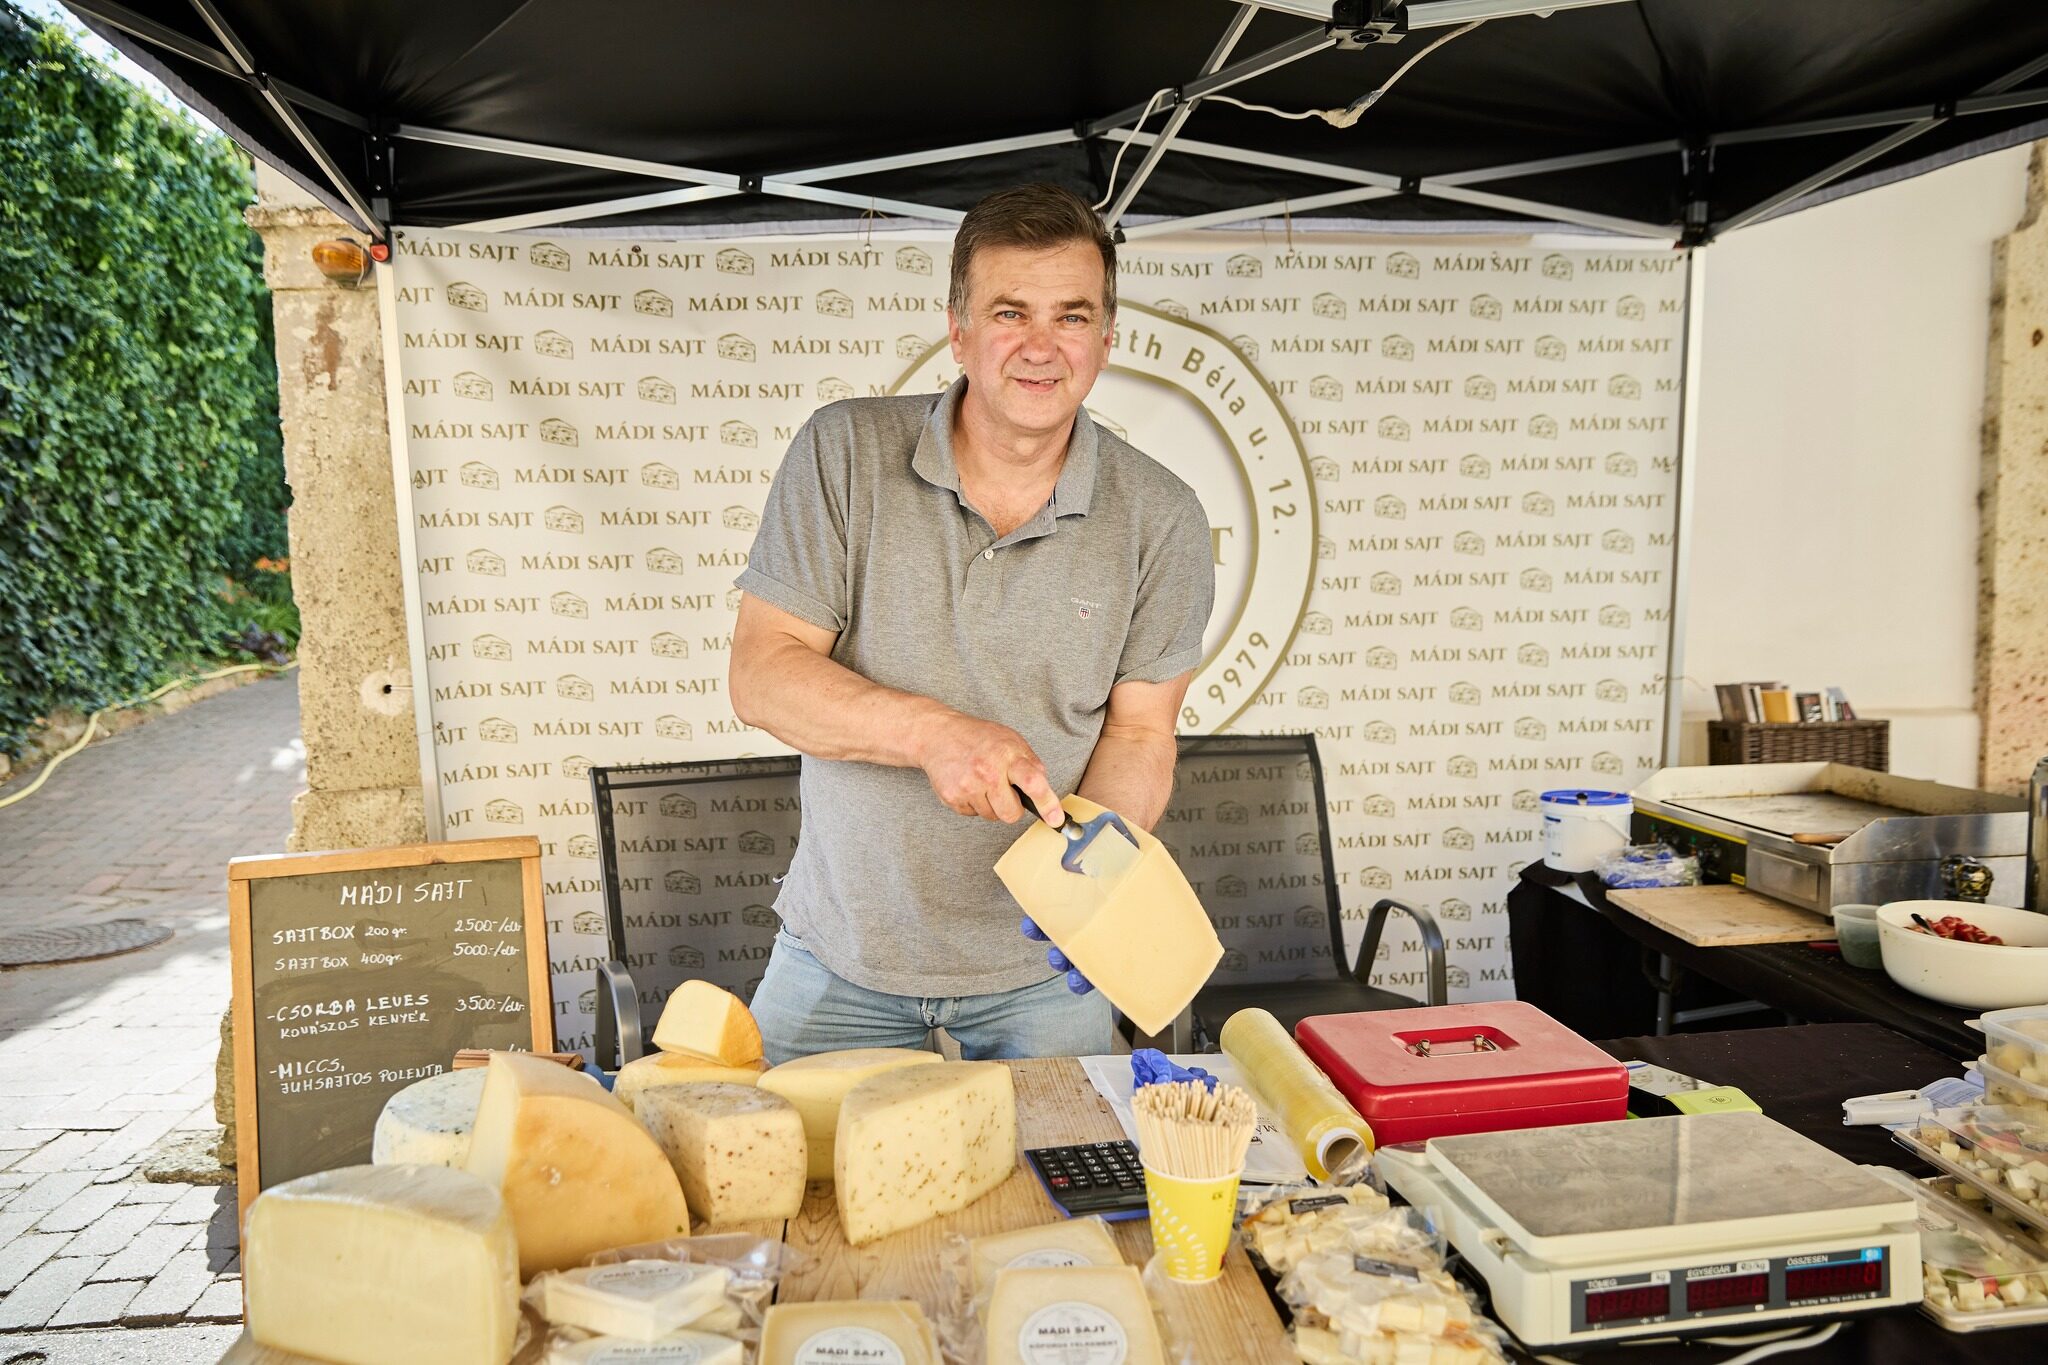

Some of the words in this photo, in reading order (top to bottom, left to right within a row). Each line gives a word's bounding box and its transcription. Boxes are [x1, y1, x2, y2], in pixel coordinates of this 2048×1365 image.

[588, 250, 649, 267] MÁDI
[657, 254, 705, 271] SAJT
[770, 248, 830, 267] MÁDI
[836, 250, 884, 269] SAJT
[1117, 256, 1164, 276] MÁDI
[1170, 263, 1211, 279] SAJT
[1433, 253, 1486, 271] MÁDI
[1490, 256, 1532, 273] SAJT
[1584, 254, 1634, 272] MÁDI
[1639, 254, 1677, 274] SAJT
[503, 288, 564, 307] MÁDI
[572, 294, 622, 311] SAJT
[1200, 295, 1255, 315] MÁDI
[1261, 298, 1302, 314] SAJT
[1358, 294, 1411, 312] MÁDI
[1417, 299, 1459, 315] SAJT
[404, 328, 468, 348] MÁDI
[475, 334, 521, 353] SAJT
[590, 333, 651, 353] MÁDI
[658, 340, 707, 357] SAJT
[772, 335, 831, 353] MÁDI
[838, 340, 885, 357] SAJT
[1271, 335, 1325, 352] MÁDI
[1331, 339, 1372, 355] SAJT
[1427, 335, 1479, 352] MÁDI
[1484, 339, 1524, 355] SAJT
[1577, 335, 1629, 352] MÁDI
[1630, 339, 1673, 354] SAJT
[509, 376, 570, 395] MÁDI
[578, 382, 625, 399] SAJT
[1355, 375, 1407, 393] MÁDI
[1412, 380, 1453, 395] SAJT
[411, 419, 473, 439] MÁDI
[480, 424, 530, 440] SAJT
[595, 420, 655, 439] MÁDI
[662, 426, 709, 442] SAJT
[1423, 415, 1474, 432] MÁDI
[1479, 419, 1519, 434] SAJT
[1569, 414, 1621, 430] MÁDI
[1627, 417, 1669, 432] SAJT
[1181, 346, 1247, 417] Béla
[1248, 426, 1269, 462] u.
[1268, 478, 1298, 535] 12.
[1351, 456, 1403, 473] MÁDI
[1408, 459, 1448, 474] SAJT
[1500, 454, 1549, 470] MÁDI
[1554, 457, 1595, 472] SAJT
[515, 463, 576, 482] MÁDI
[582, 469, 629, 485] SAJT
[1418, 494, 1469, 510] MÁDI
[1473, 496, 1510, 511] SAJT
[419, 507, 480, 528] MÁDI
[487, 512, 534, 529] SAJT
[600, 507, 659, 525] MÁDI
[665, 511, 709, 527] SAJT
[1348, 534, 1399, 551] MÁDI
[1404, 536, 1443, 551] SAJT
[1495, 530, 1547, 547] MÁDI
[1552, 534, 1591, 548] SAJT
[1413, 572, 1463, 586] MÁDI
[1469, 572, 1508, 587] SAJT
[1563, 568, 1615, 584] MÁDI
[1620, 570, 1662, 585] SAJT
[426, 594, 486, 616] MÁDI
[493, 598, 541, 614] SAJT
[605, 592, 664, 611] MÁDI
[671, 595, 716, 611] SAJT
[1070, 597, 1103, 609] GANT
[1494, 605, 1544, 623] MÁDI
[1549, 609, 1589, 624] SAJT
[527, 635, 586, 653] MÁDI
[592, 640, 639, 656] SAJT
[1410, 645, 1461, 661] MÁDI
[1467, 648, 1507, 662] SAJT
[1560, 643, 1612, 658] MÁDI
[1617, 645, 1658, 660] SAJT
[1180, 706, 1201, 729] 8
[1207, 631, 1270, 706] 9979
[1491, 681, 1541, 697] MÁDI
[1546, 684, 1586, 698] SAJT
[434, 683, 492, 702] MÁDI
[499, 681, 547, 697] SAJT
[1340, 684, 1391, 701] MÁDI
[1397, 687, 1437, 701] SAJT
[533, 718, 591, 736] MÁDI
[597, 722, 644, 737] SAJT
[1558, 716, 1609, 732] MÁDI
[1613, 719, 1653, 733] SAJT
[1339, 757, 1390, 775] MÁDI
[1395, 761, 1434, 775] SAJT
[1488, 754, 1539, 770] MÁDI
[1544, 757, 1583, 771] SAJT
[443, 765, 499, 785] MÁDI
[505, 763, 552, 778] SAJT
[1337, 832, 1387, 848] MÁDI
[1392, 833, 1431, 847] SAJT
[1404, 862, 1453, 881] MÁDI
[1458, 866, 1497, 884] SAJT
[340, 880, 403, 906] MÁDI
[413, 879, 473, 903] SAJT
[364, 925, 390, 937] 200
[378, 1063, 444, 1083] POLENTA
